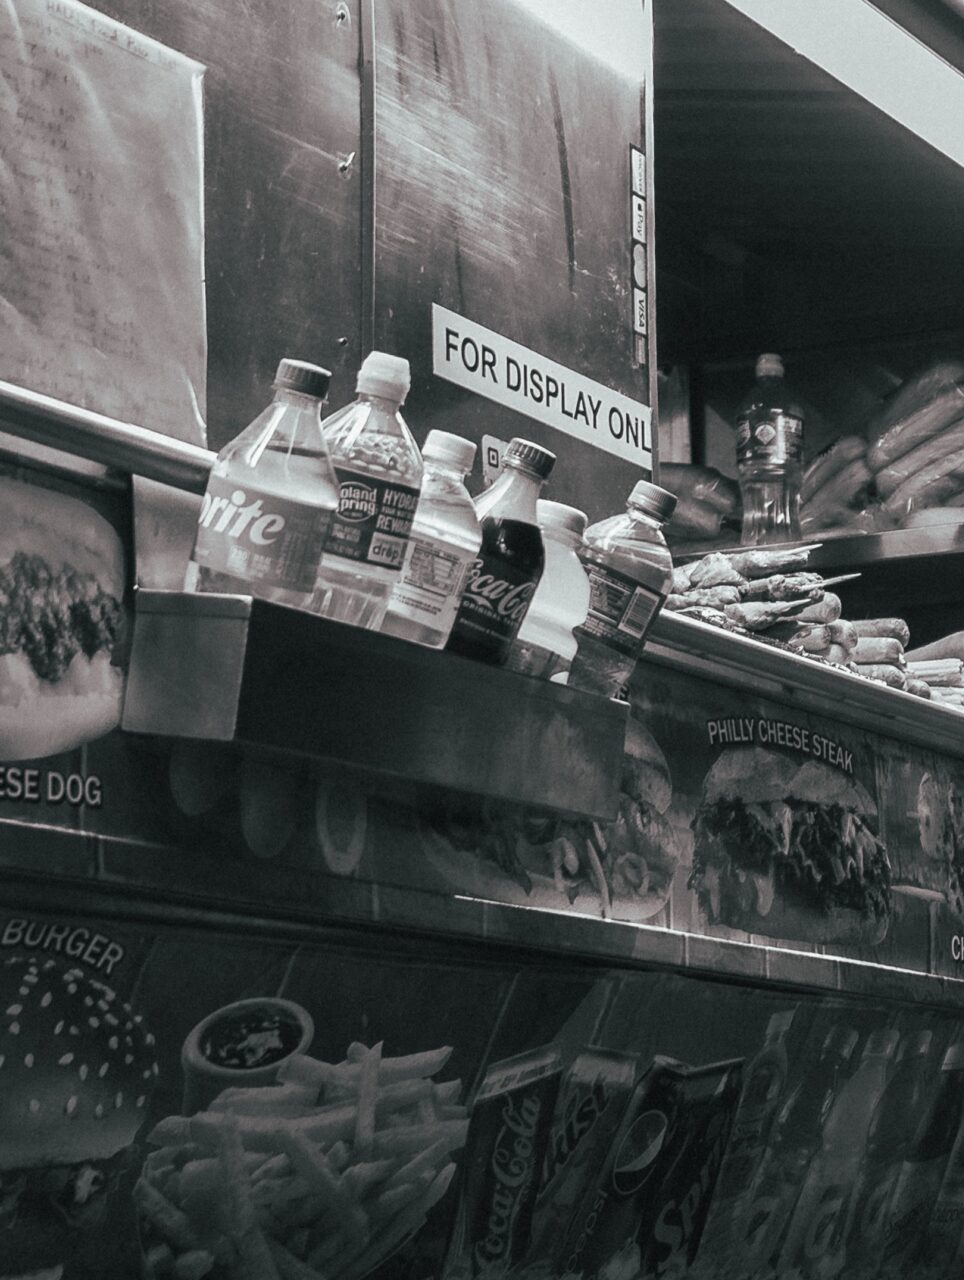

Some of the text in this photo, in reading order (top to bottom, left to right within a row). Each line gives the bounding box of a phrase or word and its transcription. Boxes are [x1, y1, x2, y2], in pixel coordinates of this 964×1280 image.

[638, 299, 646, 328] VISA
[445, 327, 498, 383] FOR
[506, 356, 602, 429] DISPLAY
[337, 499, 377, 516] pring
[707, 718, 854, 774] PHILLY CHEESE STEAK
[47, 770, 102, 806] DOG
[1, 919, 124, 975] BURGER
